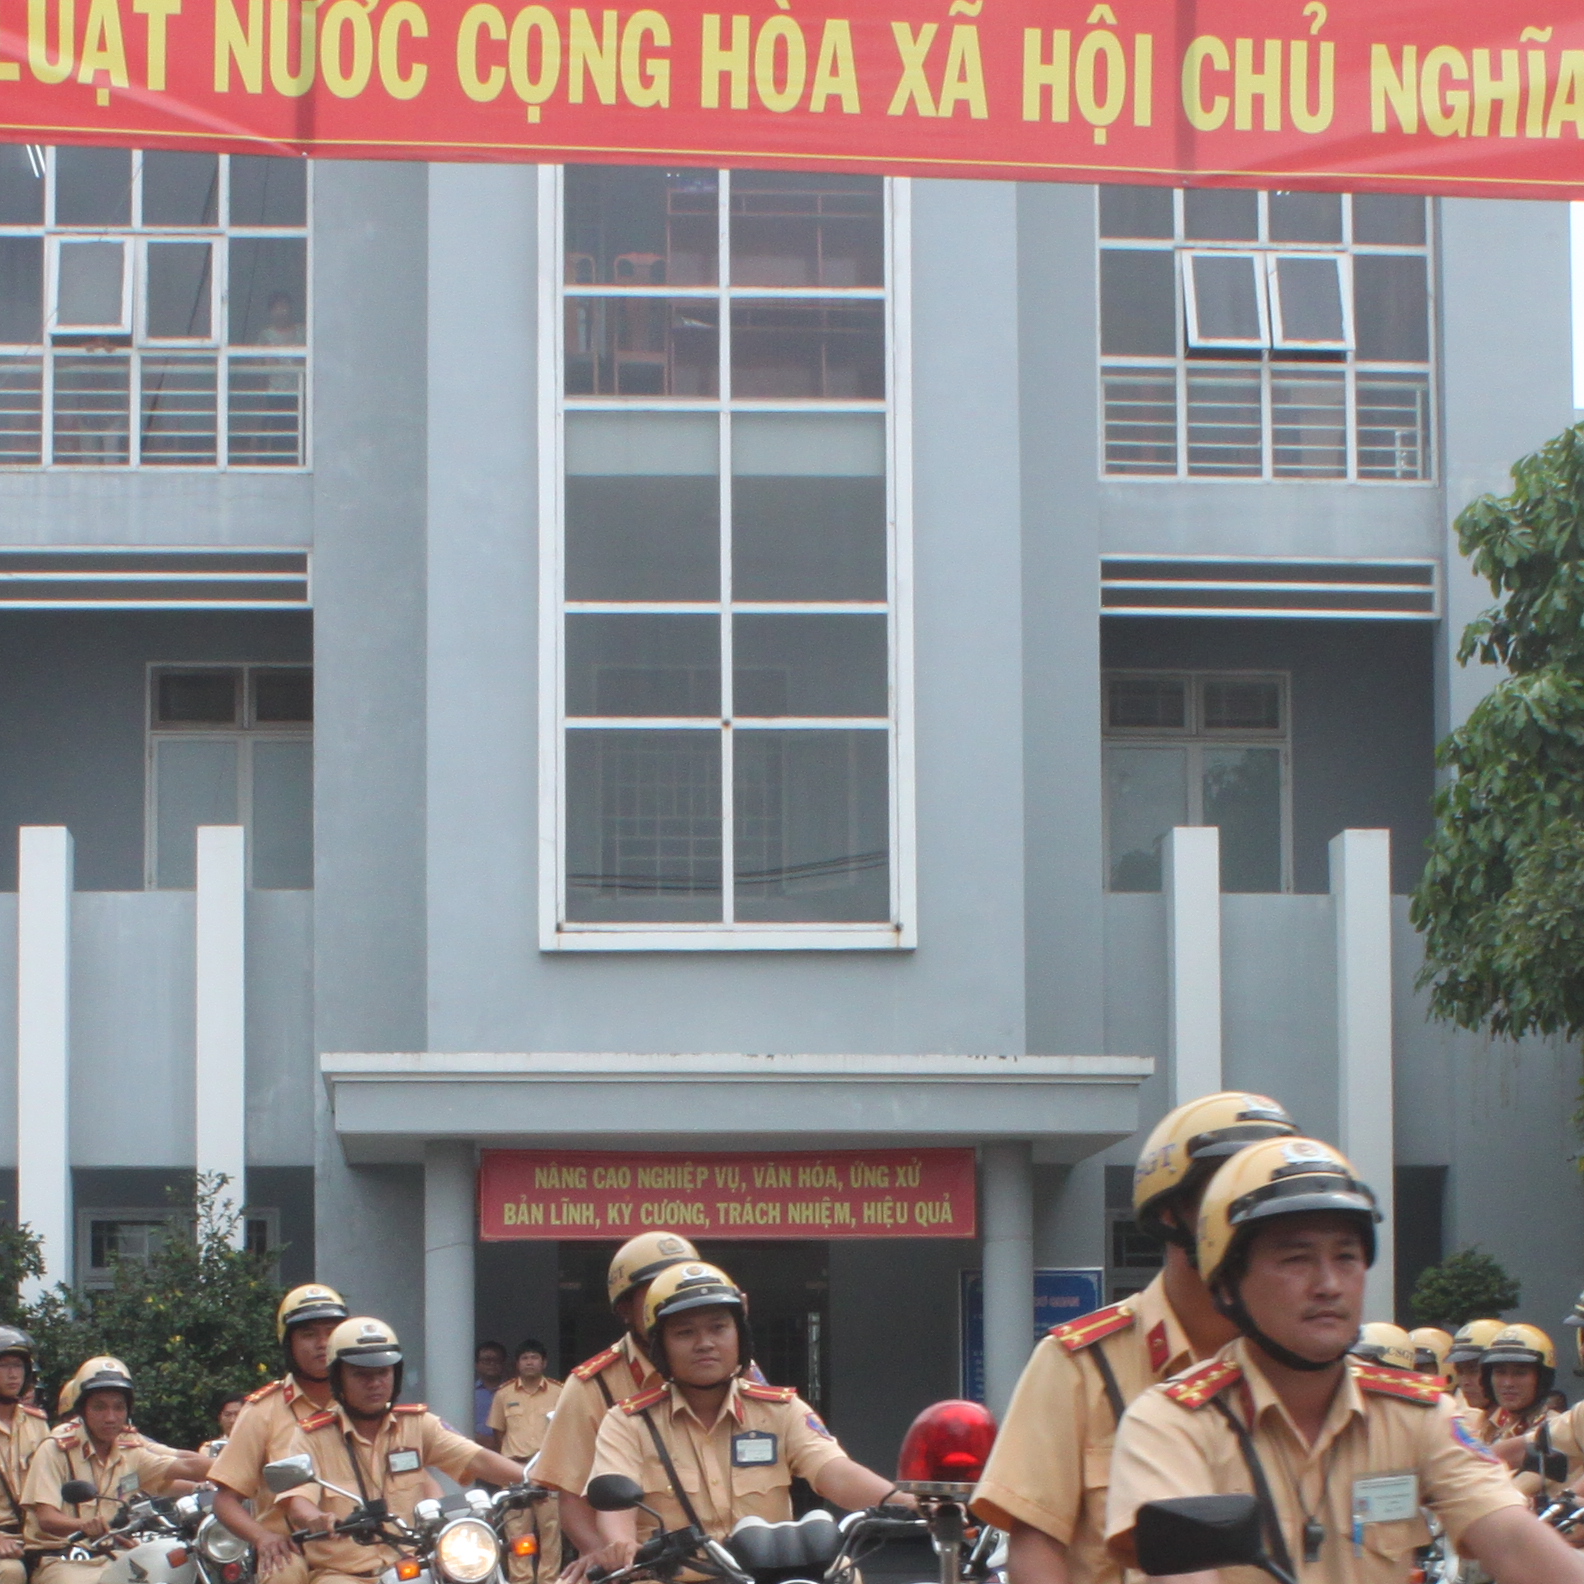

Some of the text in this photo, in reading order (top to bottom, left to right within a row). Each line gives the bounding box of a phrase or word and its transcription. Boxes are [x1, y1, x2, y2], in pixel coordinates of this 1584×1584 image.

[700, 0, 861, 115] HÒA
[887, 0, 989, 119] XÃ
[1022, 3, 1153, 146] HỘI
[1180, 1, 1335, 134] CHỦ
[534, 1162, 588, 1189] NÂNG
[592, 1166, 631, 1189] CAO
[637, 1161, 710, 1193] NGHIỆP
[715, 1166, 747, 1193] VỤ,
[753, 1161, 792, 1189] VĂN
[798, 1160, 843, 1193] HÓA,
[895, 1157, 923, 1189] XỬ
[503, 1194, 544, 1225] BẢN
[549, 1197, 601, 1229] LĨNH,
[639, 1198, 711, 1230] CƯƠNG,
[716, 1197, 781, 1225] TRÁCH
[787, 1196, 857, 1229] NHIỆM,
[863, 1195, 909, 1228] HIỆU
[914, 1193, 954, 1227] QUẢ
